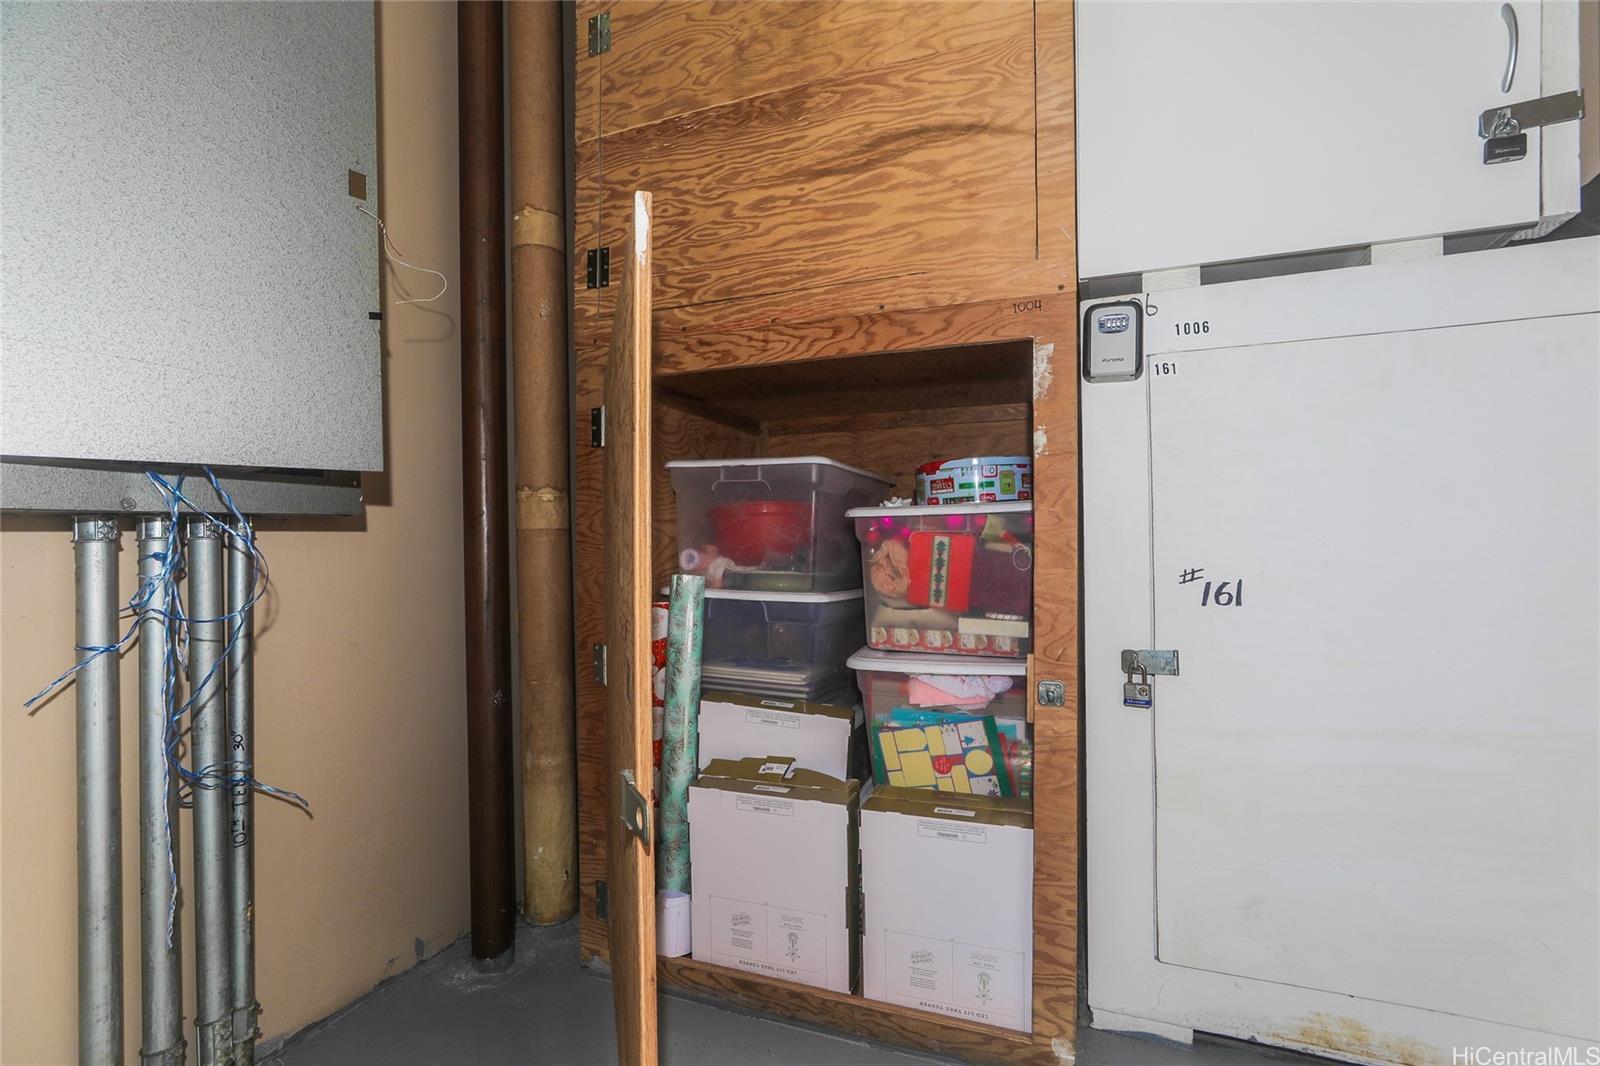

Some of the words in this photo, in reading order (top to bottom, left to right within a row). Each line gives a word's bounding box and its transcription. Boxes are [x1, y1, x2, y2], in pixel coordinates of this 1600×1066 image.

[1012, 299, 1042, 314] 1004
[1175, 320, 1210, 336] 1006
[1154, 362, 1177, 376] 161
[919, 1001, 944, 1012] TOPPER
